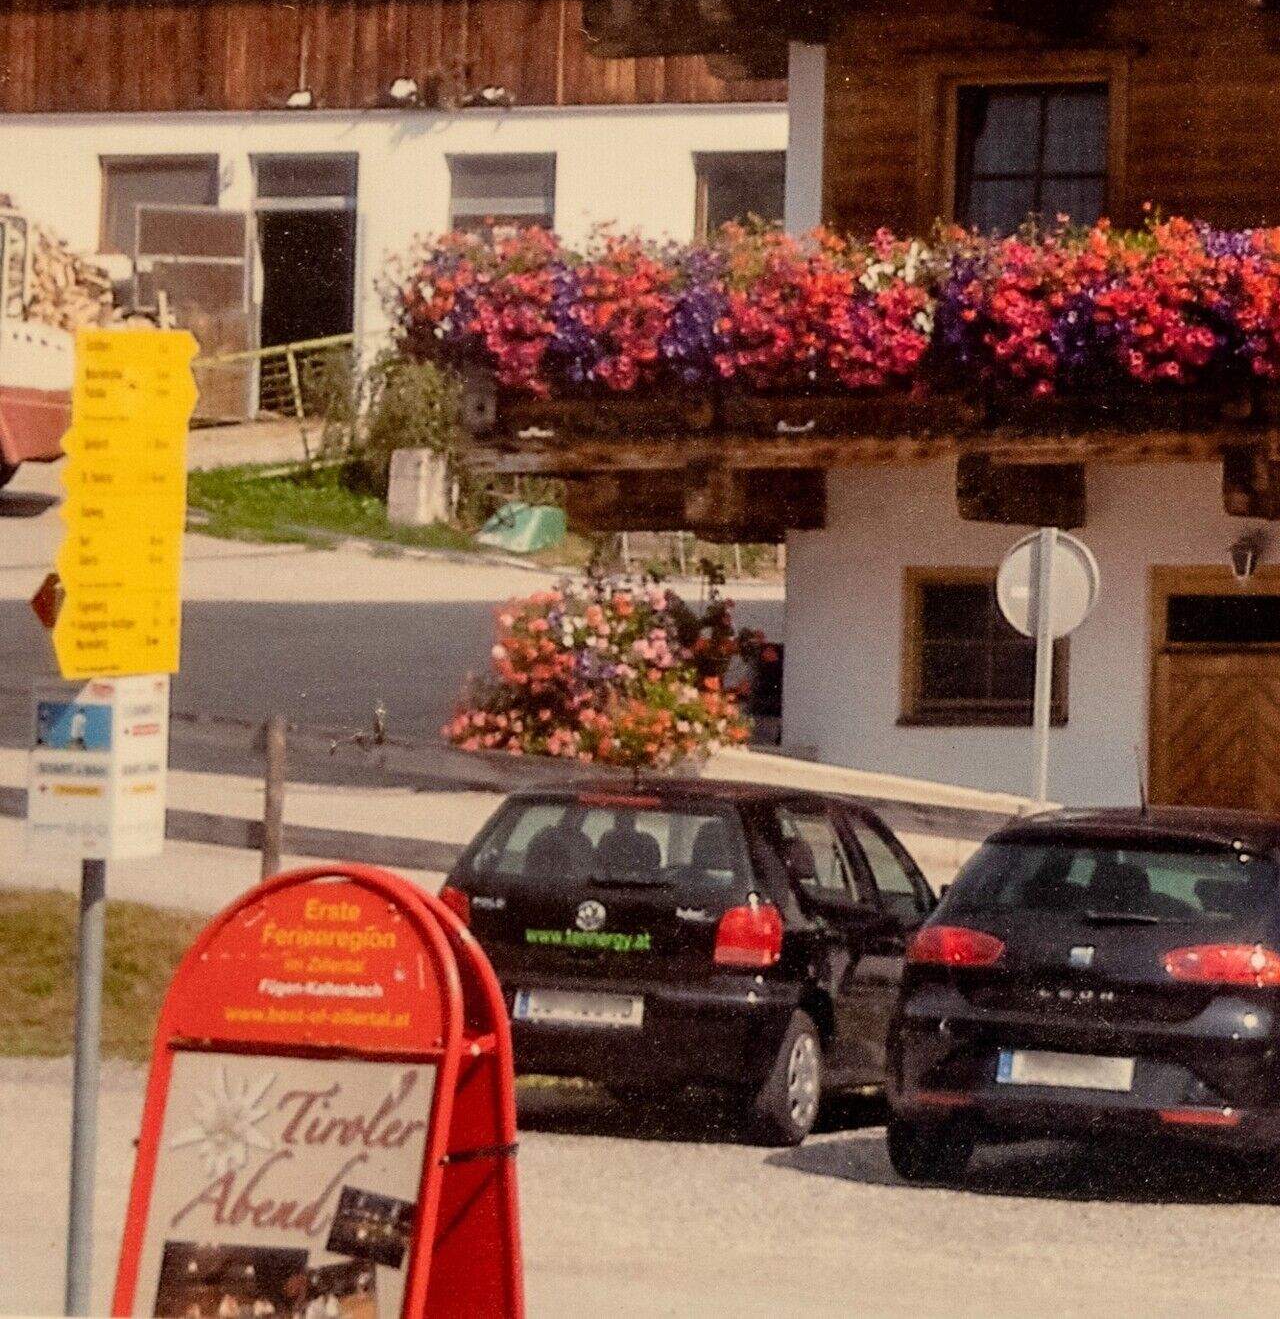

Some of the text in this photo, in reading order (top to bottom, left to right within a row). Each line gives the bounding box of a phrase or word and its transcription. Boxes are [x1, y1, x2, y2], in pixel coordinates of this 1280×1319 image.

[304, 897, 362, 922] Erste
[276, 1068, 427, 1149] Tiroler
[171, 1149, 371, 1237] Abend
